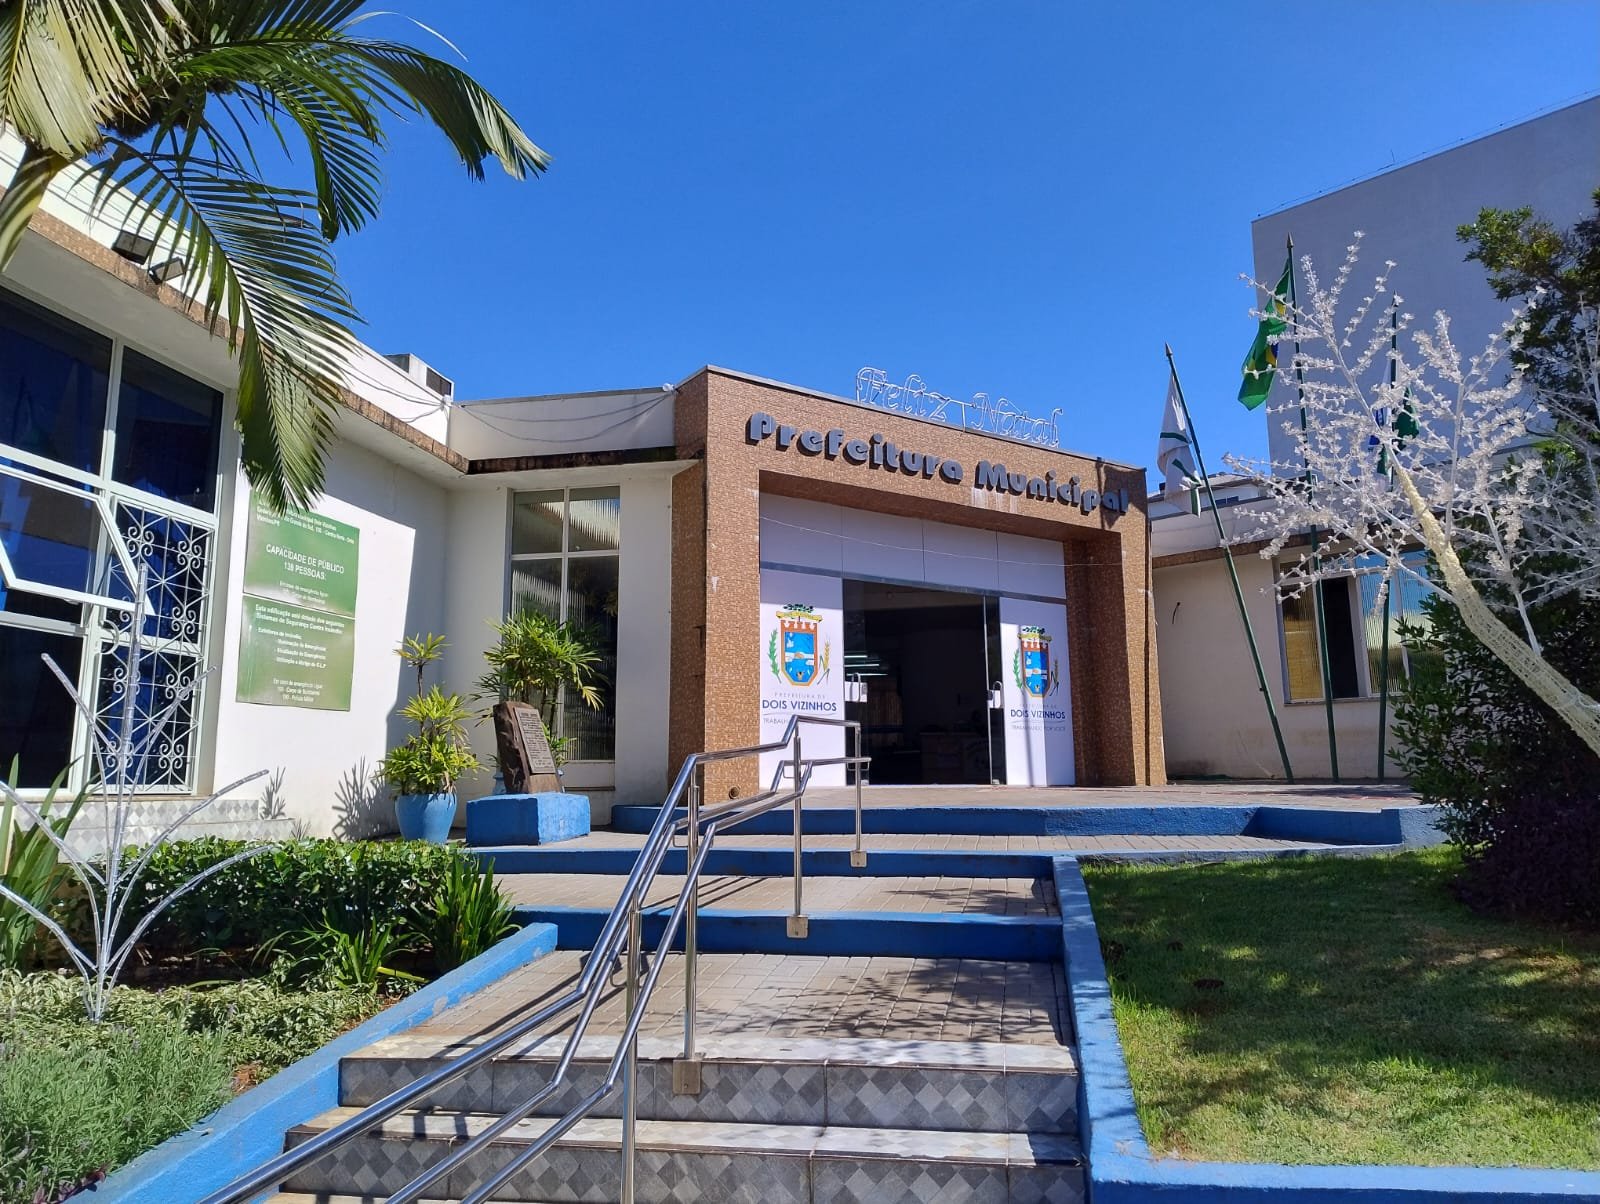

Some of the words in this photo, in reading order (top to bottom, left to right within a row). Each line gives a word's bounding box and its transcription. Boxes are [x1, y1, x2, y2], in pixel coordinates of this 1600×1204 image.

[746, 412, 964, 484] Prefeitura
[975, 460, 1128, 516] Municipal
[266, 544, 307, 564] CAPACIDADE
[307, 556, 317, 567] DE
[318, 558, 345, 574] PÚBLICO
[762, 700, 788, 710] DOIS
[790, 700, 837, 712] VIZINHOS
[1010, 709, 1029, 718] DOIS
[1031, 710, 1066, 719] VIZINHOS
